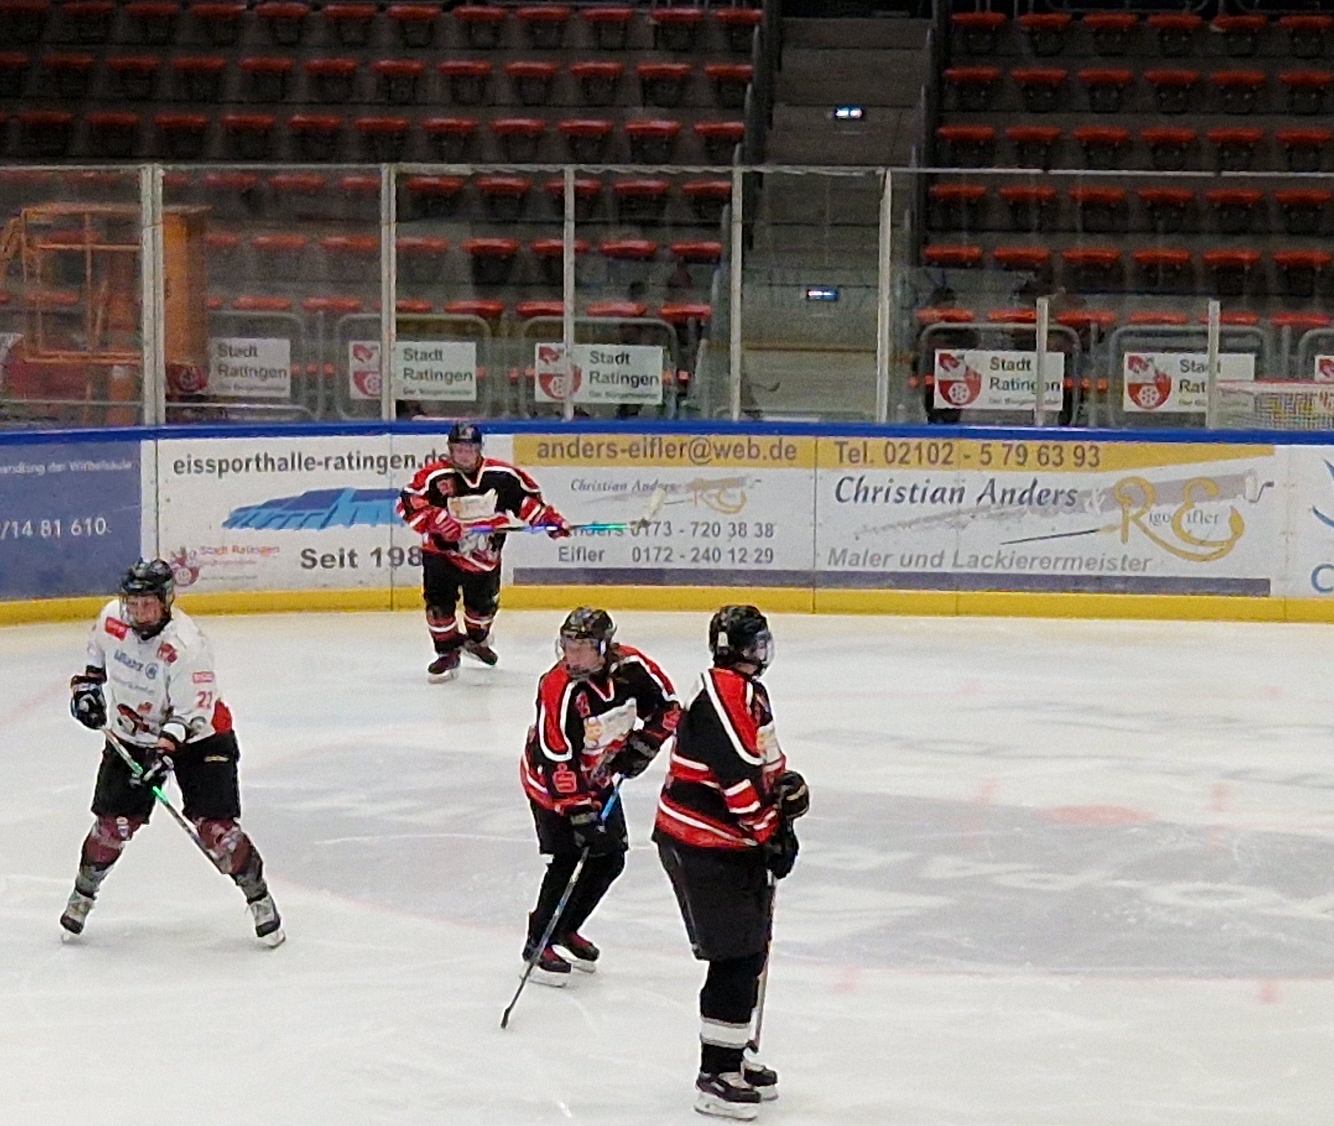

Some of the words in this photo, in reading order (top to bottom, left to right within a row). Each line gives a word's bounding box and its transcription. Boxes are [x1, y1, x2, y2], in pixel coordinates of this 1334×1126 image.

[216, 343, 259, 360] Stadt
[403, 347, 444, 362] Stadt
[589, 350, 631, 366] Stadt
[216, 362, 289, 383] Ratingen
[989, 356, 1032, 372] Stadt
[403, 367, 473, 386] Ratingen
[589, 370, 659, 389] Ratingen
[989, 376, 1061, 395] Ratingn
[536, 437, 798, 466] anders-eifler@web.de
[834, 441, 872, 465] Tel.
[883, 443, 955, 465] 02102
[980, 443, 993, 465] 5
[1001, 443, 1028, 466] 79
[1036, 444, 1065, 466] 63
[1072, 444, 1101, 467] 93
[570, 478, 628, 493] Christian
[834, 475, 966, 505] Christian
[976, 478, 1079, 507] Anders
[40, 519, 62, 539] 81
[71, 517, 108, 538] 610
[690, 521, 722, 538] 720
[728, 522, 748, 538] 38
[754, 522, 774, 539] 38
[300, 546, 359, 570] Seit
[369, 545, 425, 570] 198
[558, 546, 605, 562] Eifler
[632, 547, 674, 563] 0172
[690, 547, 722, 563] 240
[728, 547, 748, 563] 12
[754, 548, 774, 564] 29
[827, 548, 893, 568] Maler
[899, 549, 944, 569] und
[953, 549, 1154, 573] Lackierermeister
